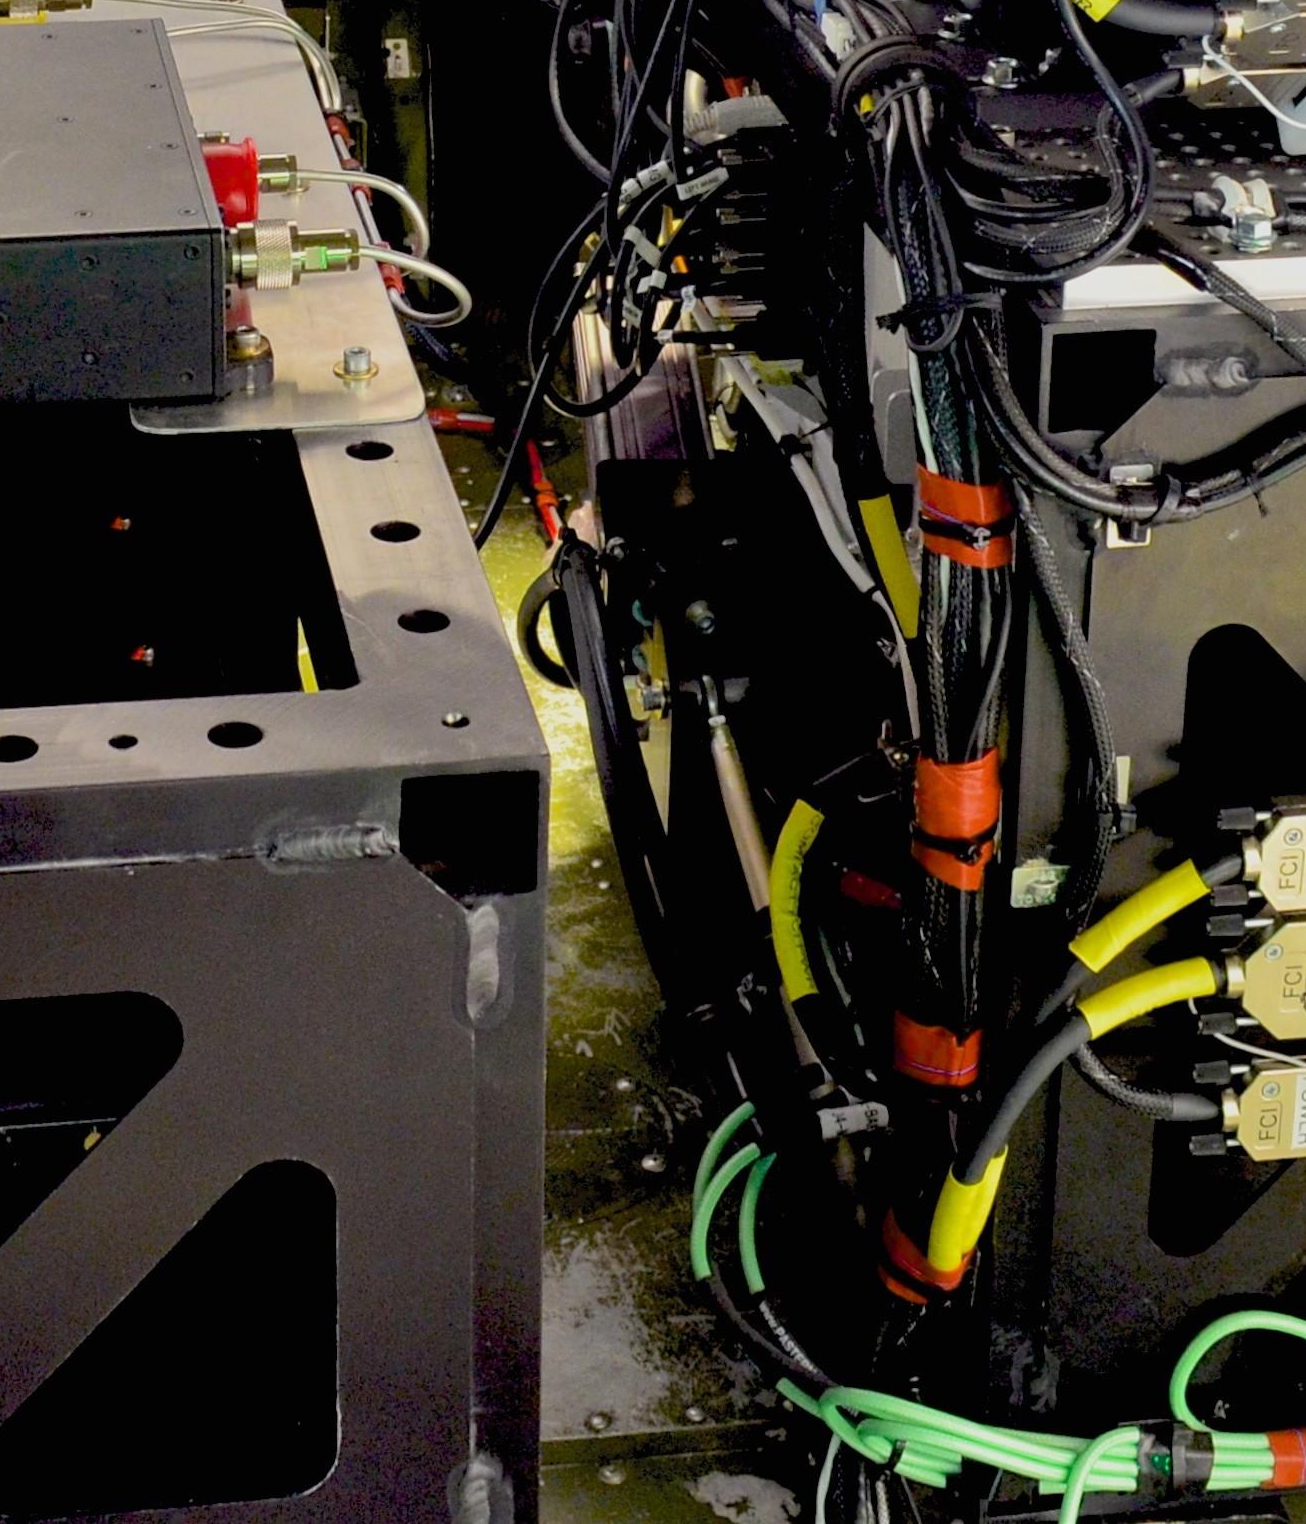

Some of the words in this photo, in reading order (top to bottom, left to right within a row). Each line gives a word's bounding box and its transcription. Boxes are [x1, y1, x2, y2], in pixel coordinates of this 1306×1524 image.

[1278, 854, 1299, 890] FCI
[1282, 965, 1303, 999] FCI
[1258, 1107, 1278, 1141] FCI
